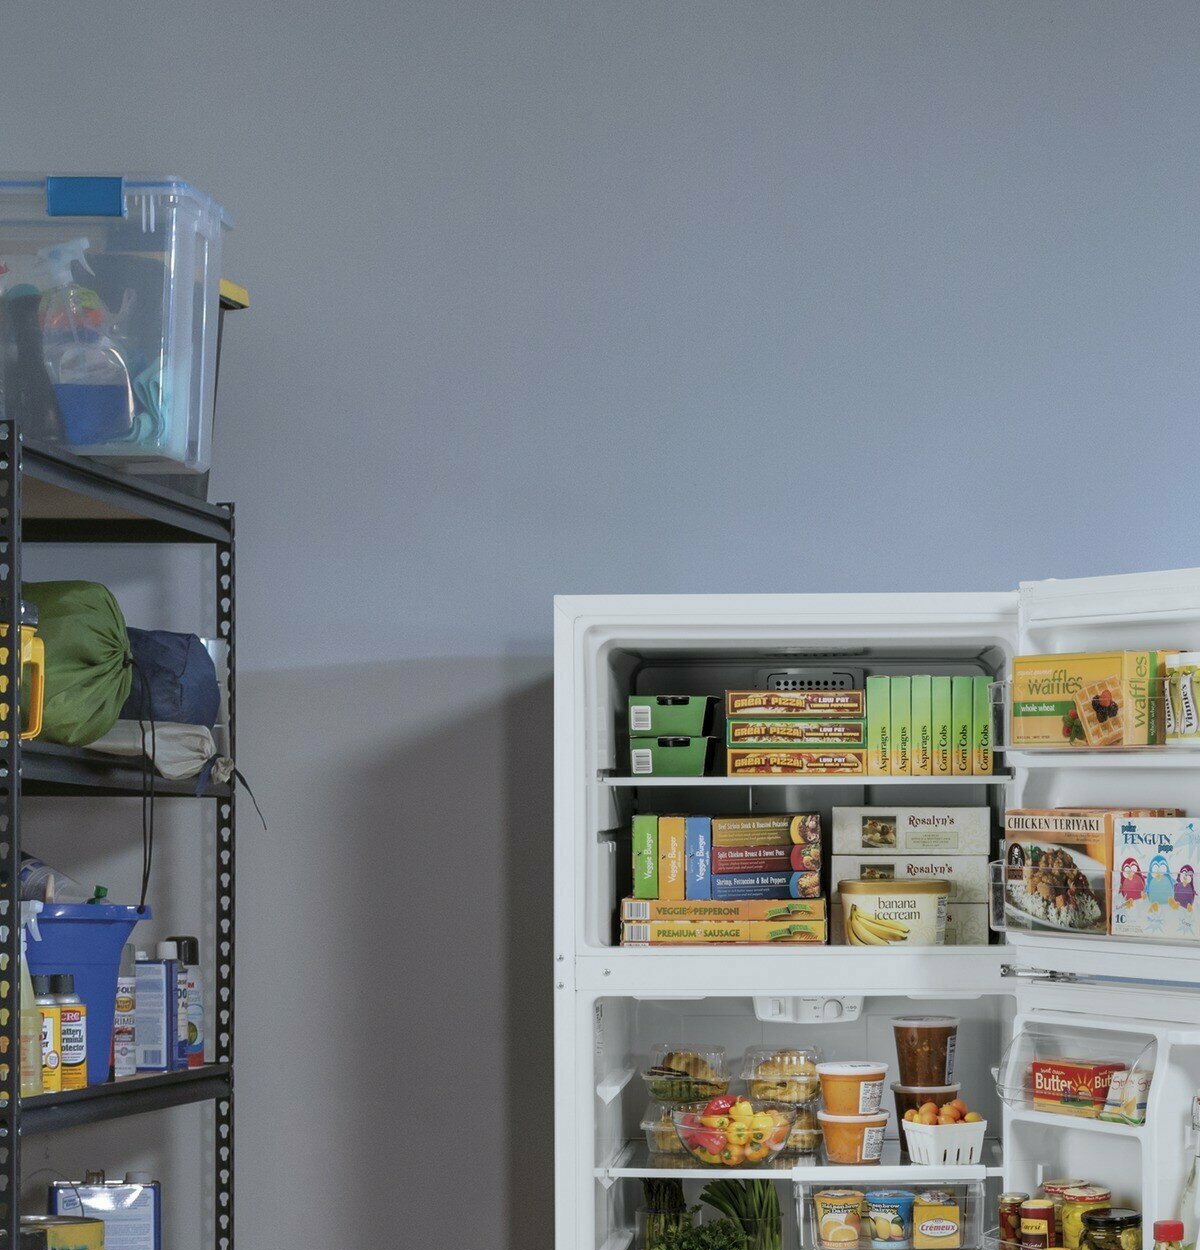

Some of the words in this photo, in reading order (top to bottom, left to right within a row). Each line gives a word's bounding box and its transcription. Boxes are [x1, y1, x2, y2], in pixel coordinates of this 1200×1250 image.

[1028, 669, 1083, 695] waffles
[1129, 655, 1148, 728] waffles
[734, 697, 768, 708] GREAT
[771, 697, 805, 708] PIZZA!
[1021, 704, 1038, 712] whole
[1038, 703, 1056, 712] wheat
[1181, 684, 1194, 728] Vinnie's
[734, 726, 767, 737] GREAT
[770, 726, 802, 737] PIZZA!
[939, 724, 948, 747] Cobs
[959, 724, 967, 747] Cobs
[880, 726, 889, 772] Asparagus
[899, 726, 909, 772] Asparagus
[920, 725, 930, 771] Asparagus
[734, 757, 767, 768] GREAT
[770, 757, 802, 768] PIZZA!
[939, 749, 948, 771] Corn
[959, 749, 967, 771] Corn
[908, 815, 955, 828] Rosalyn's
[1007, 817, 1050, 830] CHICKEN
[1052, 819, 1099, 831] TERIYAKI
[643, 832, 654, 855] Burger
[695, 834, 706, 857] Burger
[1123, 833, 1173, 845] PENGUIN
[667, 835, 678, 859] Burger
[717, 851, 727, 859] Split
[763, 849, 774, 857] Sweet
[643, 857, 654, 880] Veggie
[667, 860, 678, 883] Veggie
[696, 858, 706, 882] Veggie
[906, 863, 953, 876] Rosalyn's
[769, 876, 787, 885] Peppers
[878, 897, 917, 909] banana
[656, 907, 687, 915] VEGGIE
[693, 906, 740, 916] PEPPERONI
[874, 909, 921, 921] icecream
[657, 929, 696, 938] PREMIUM
[703, 929, 740, 938] SAUSAGE
[61, 1012, 80, 1021] CRC
[61, 1027, 82, 1037] attery
[61, 1045, 85, 1053] otector
[1035, 1072, 1073, 1092] Butter
[1094, 1075, 1112, 1089] But
